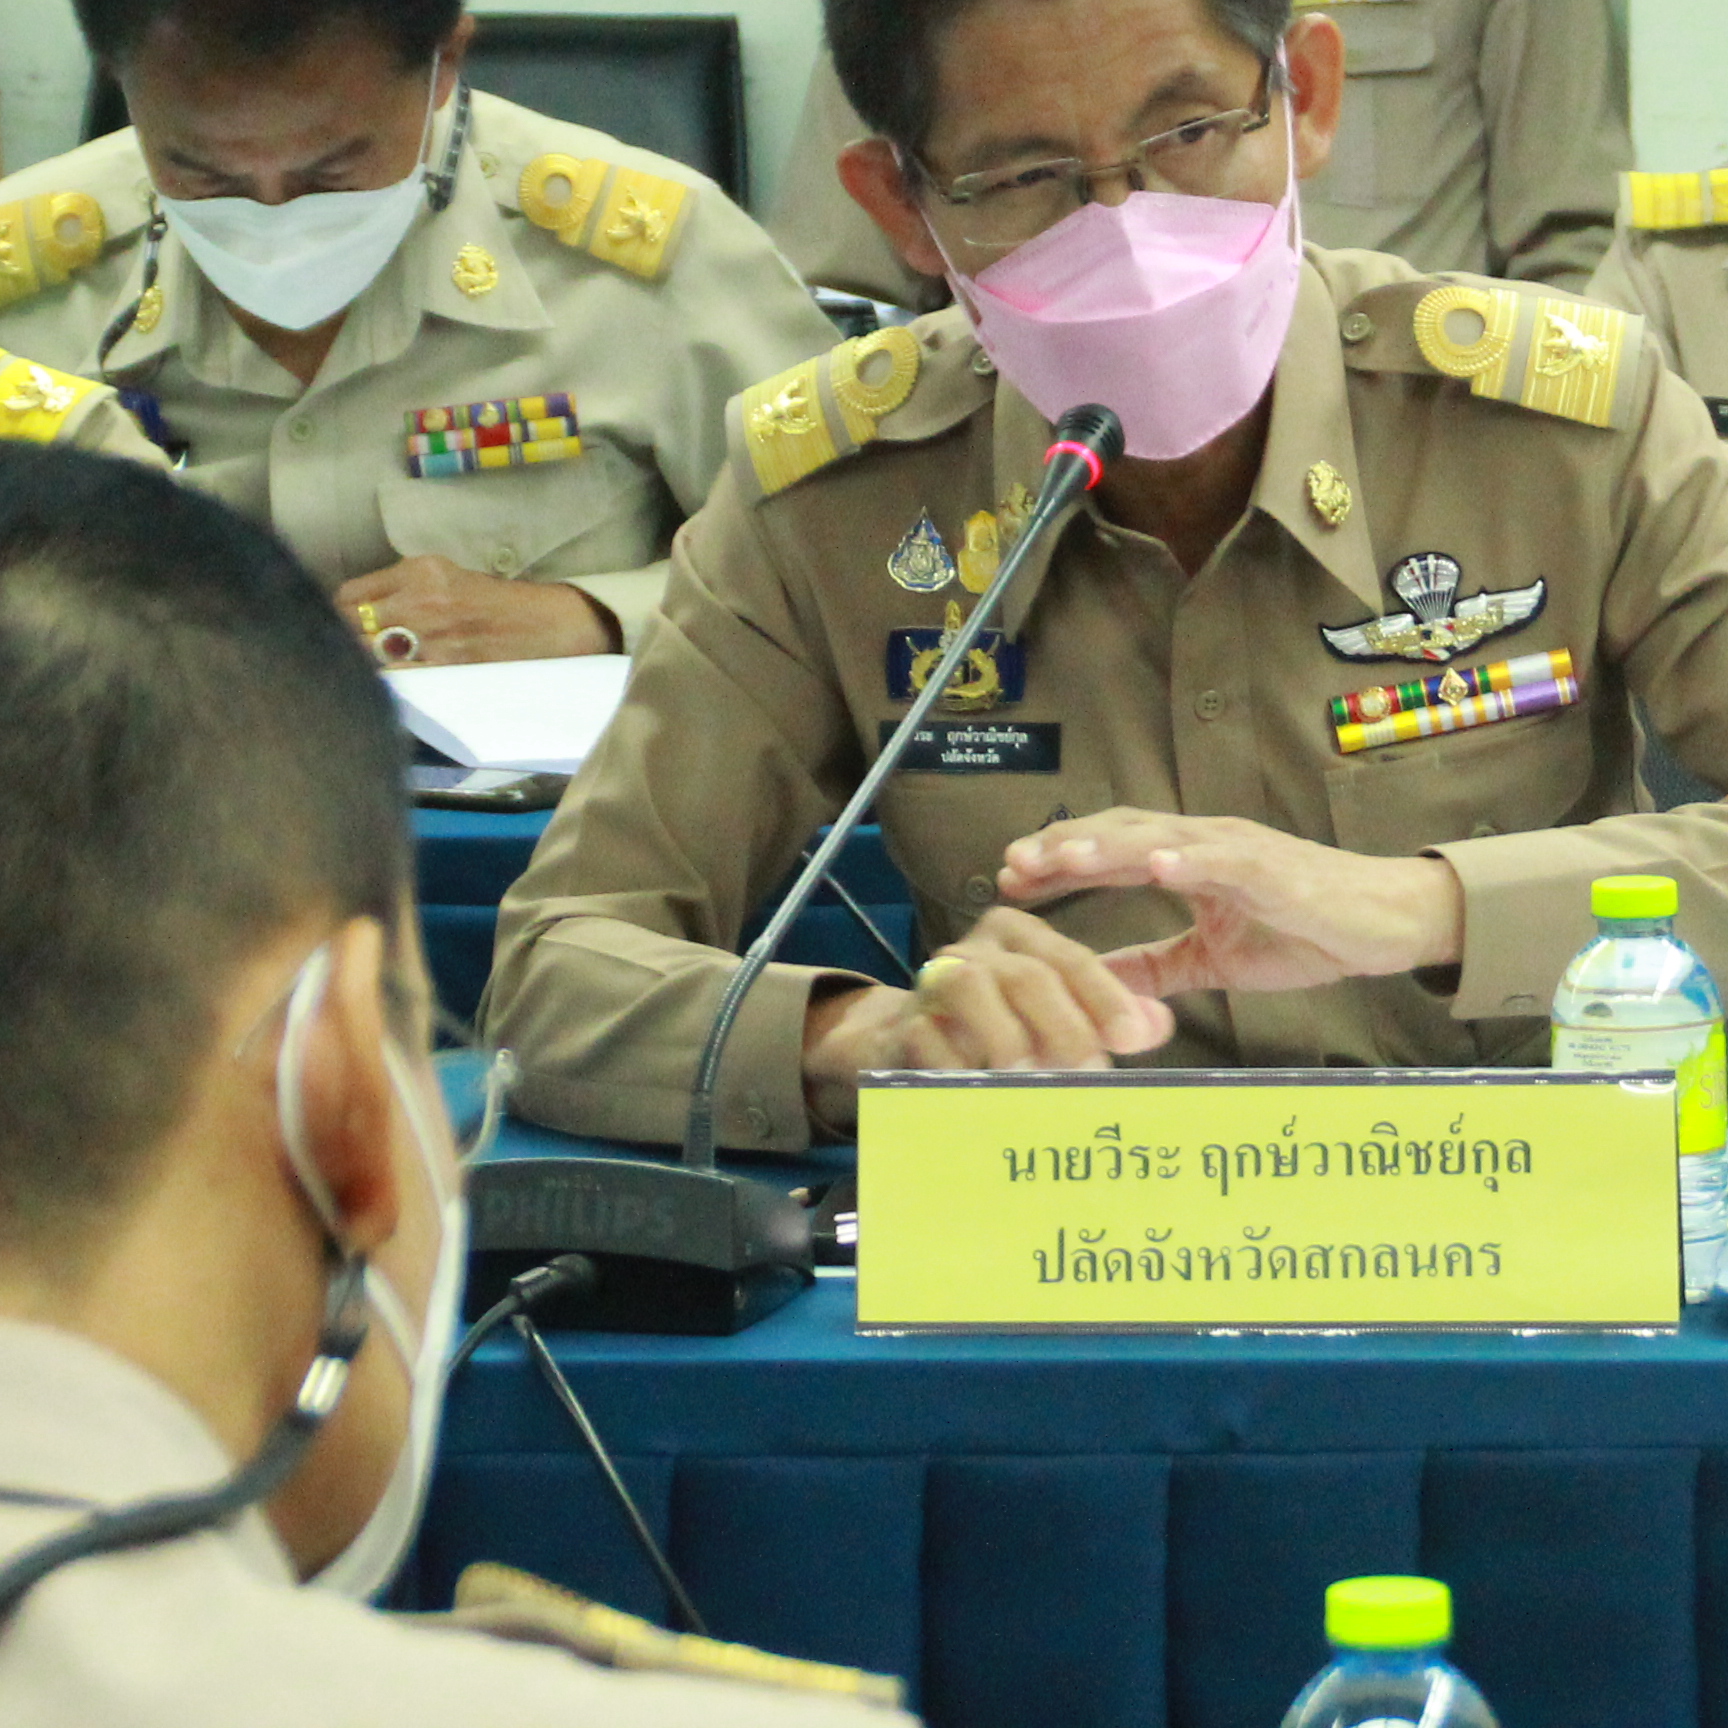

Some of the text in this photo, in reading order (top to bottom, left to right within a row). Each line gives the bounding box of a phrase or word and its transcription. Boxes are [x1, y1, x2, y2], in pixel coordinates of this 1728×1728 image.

[1002, 1113, 1534, 1196] นายวีระ ฤกษ์วาณิชย์กุล
[1032, 1225, 1503, 1285] ปลัดจังหวัดสกลนคร
